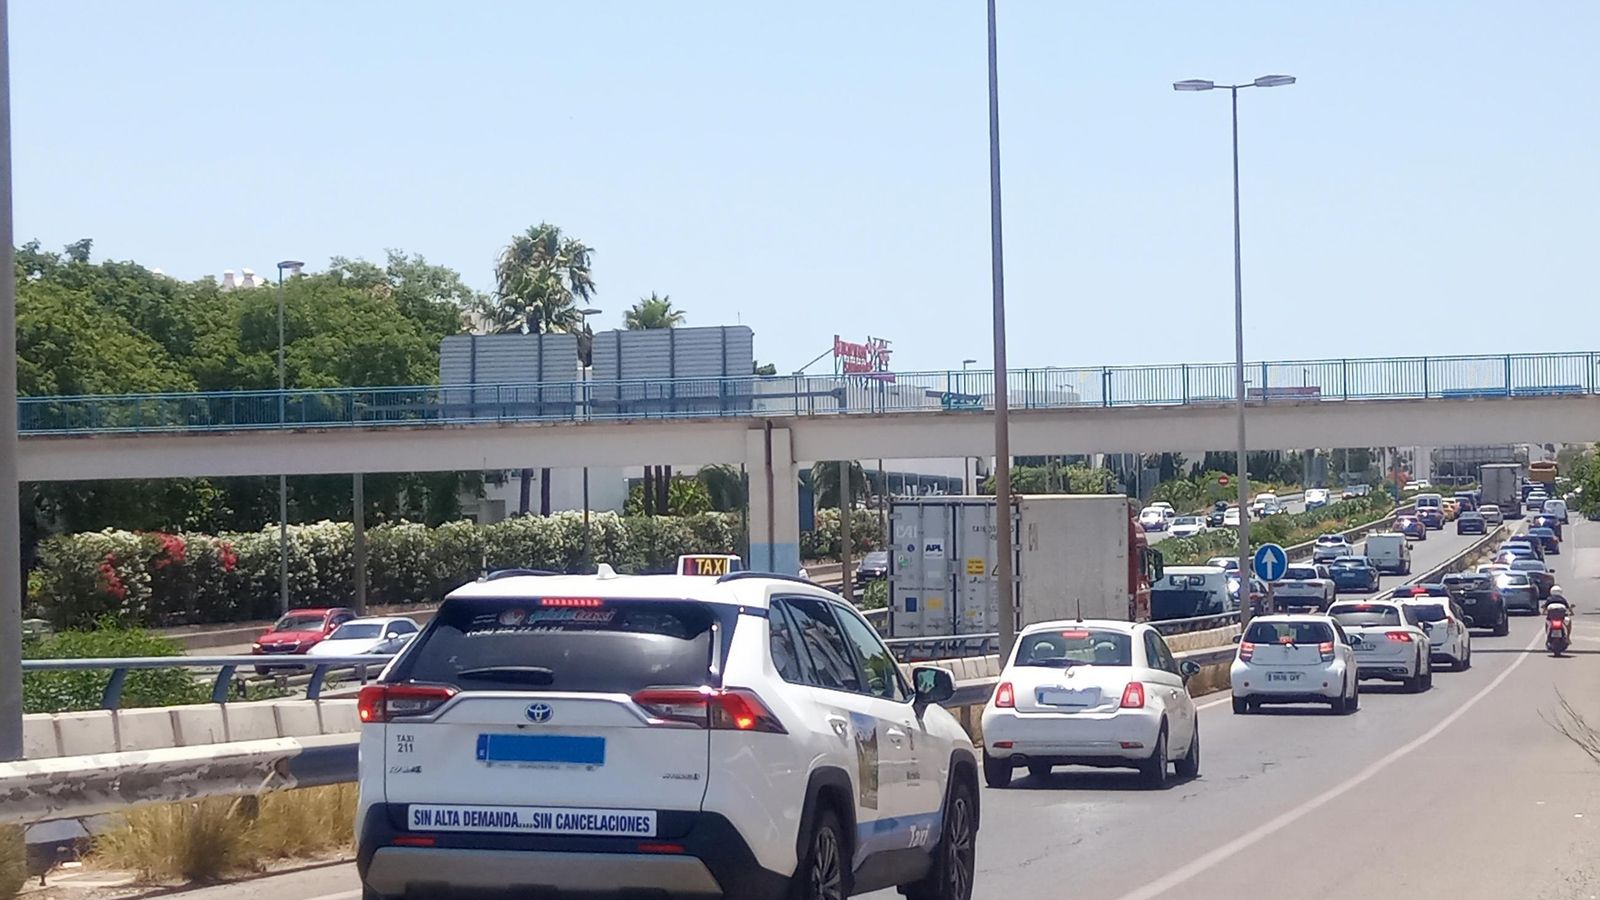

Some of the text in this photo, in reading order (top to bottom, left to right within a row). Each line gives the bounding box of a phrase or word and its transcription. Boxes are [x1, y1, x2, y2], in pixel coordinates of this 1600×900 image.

[925, 543, 943, 552] APL
[695, 559, 728, 575] TAXI
[397, 734, 414, 743] TAXI
[397, 743, 414, 753] 211
[413, 809, 432, 826] SIN
[434, 810, 460, 827] ALTA
[556, 813, 650, 833] CANCELACIONES
